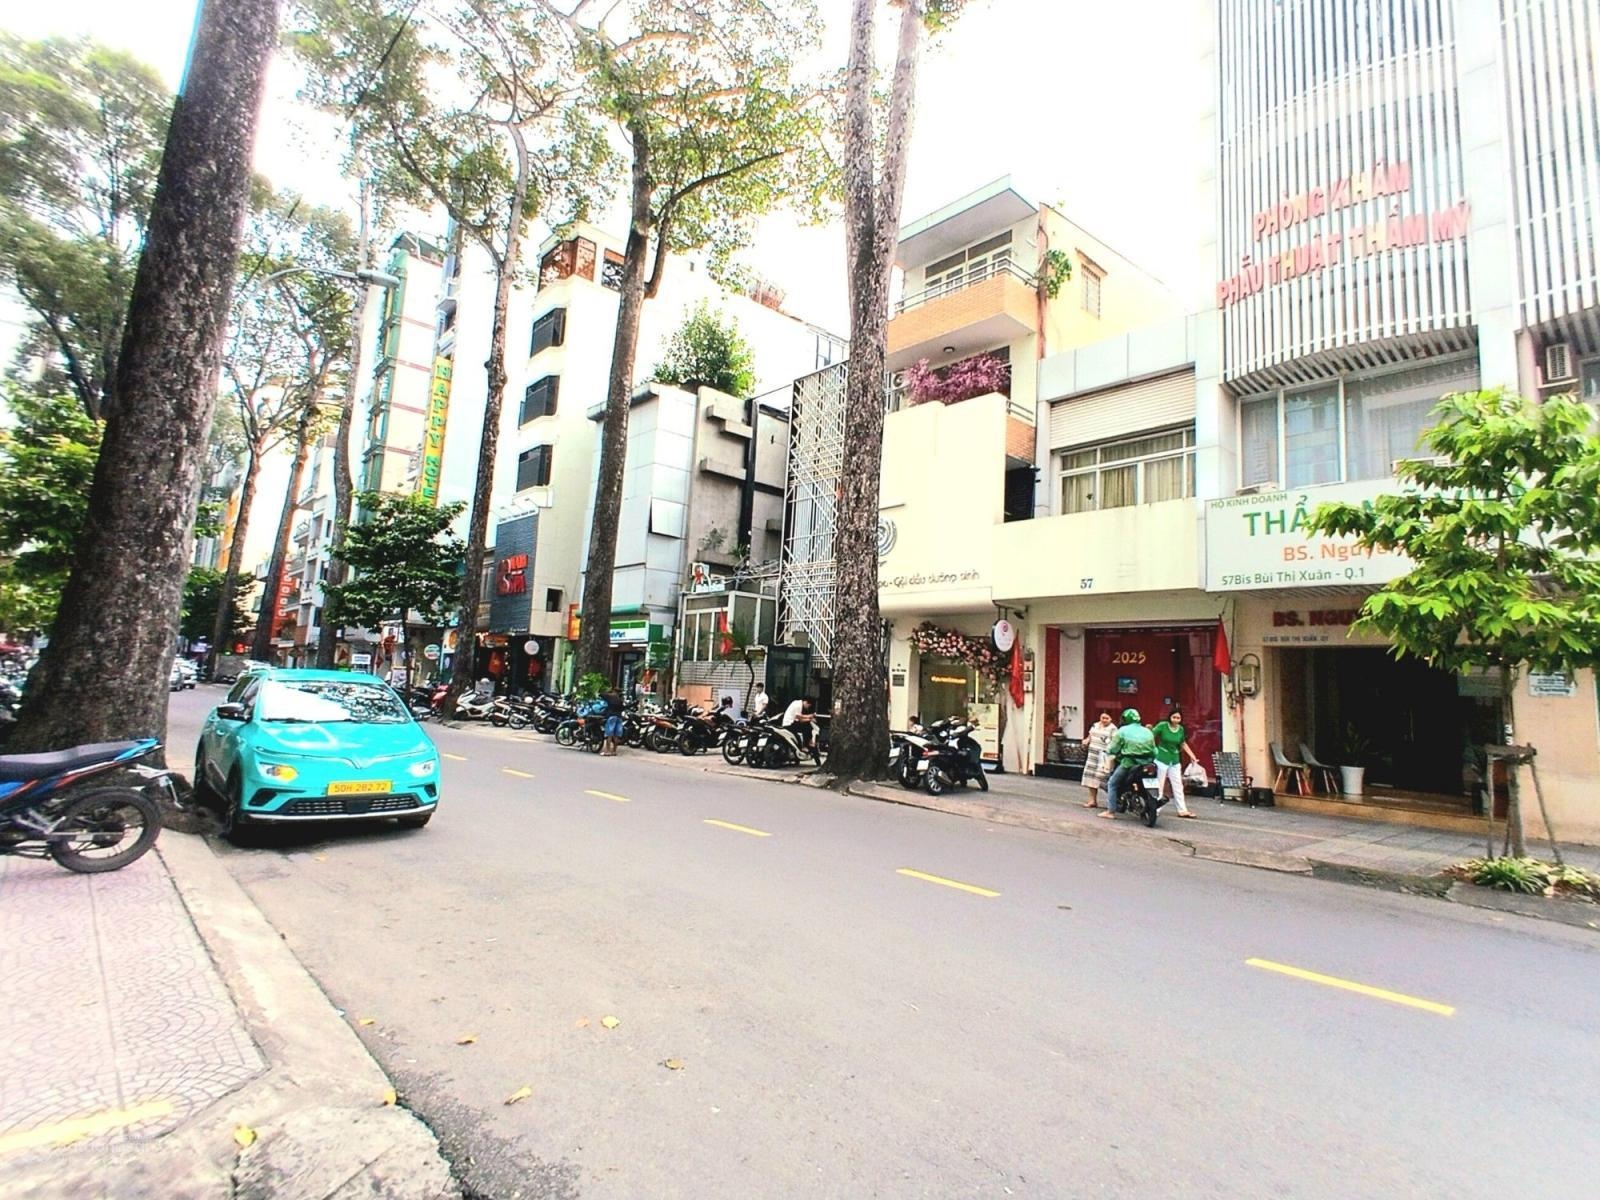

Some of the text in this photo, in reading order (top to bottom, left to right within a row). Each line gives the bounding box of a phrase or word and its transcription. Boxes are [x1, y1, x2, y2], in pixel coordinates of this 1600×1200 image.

[1254, 158, 1410, 242] PHÒNG KHÁM
[1216, 198, 1471, 309] PHẪU THUẬT THẨM MỸ
[428, 364, 451, 449] HAPPY
[1211, 494, 1288, 509] HỘ KINH DOANH
[1243, 496, 1316, 537] THẨ
[1283, 543, 1400, 563] BS. Nguy
[1080, 578, 1093, 589] 57
[1222, 572, 1251, 586] 57Bis
[1254, 570, 1273, 584] Bùi
[1277, 570, 1295, 583] Thị
[1299, 569, 1331, 581] Xuân
[1345, 567, 1365, 580] Q.1
[1273, 610, 1304, 627] BS.
[1112, 651, 1147, 664] 2025
